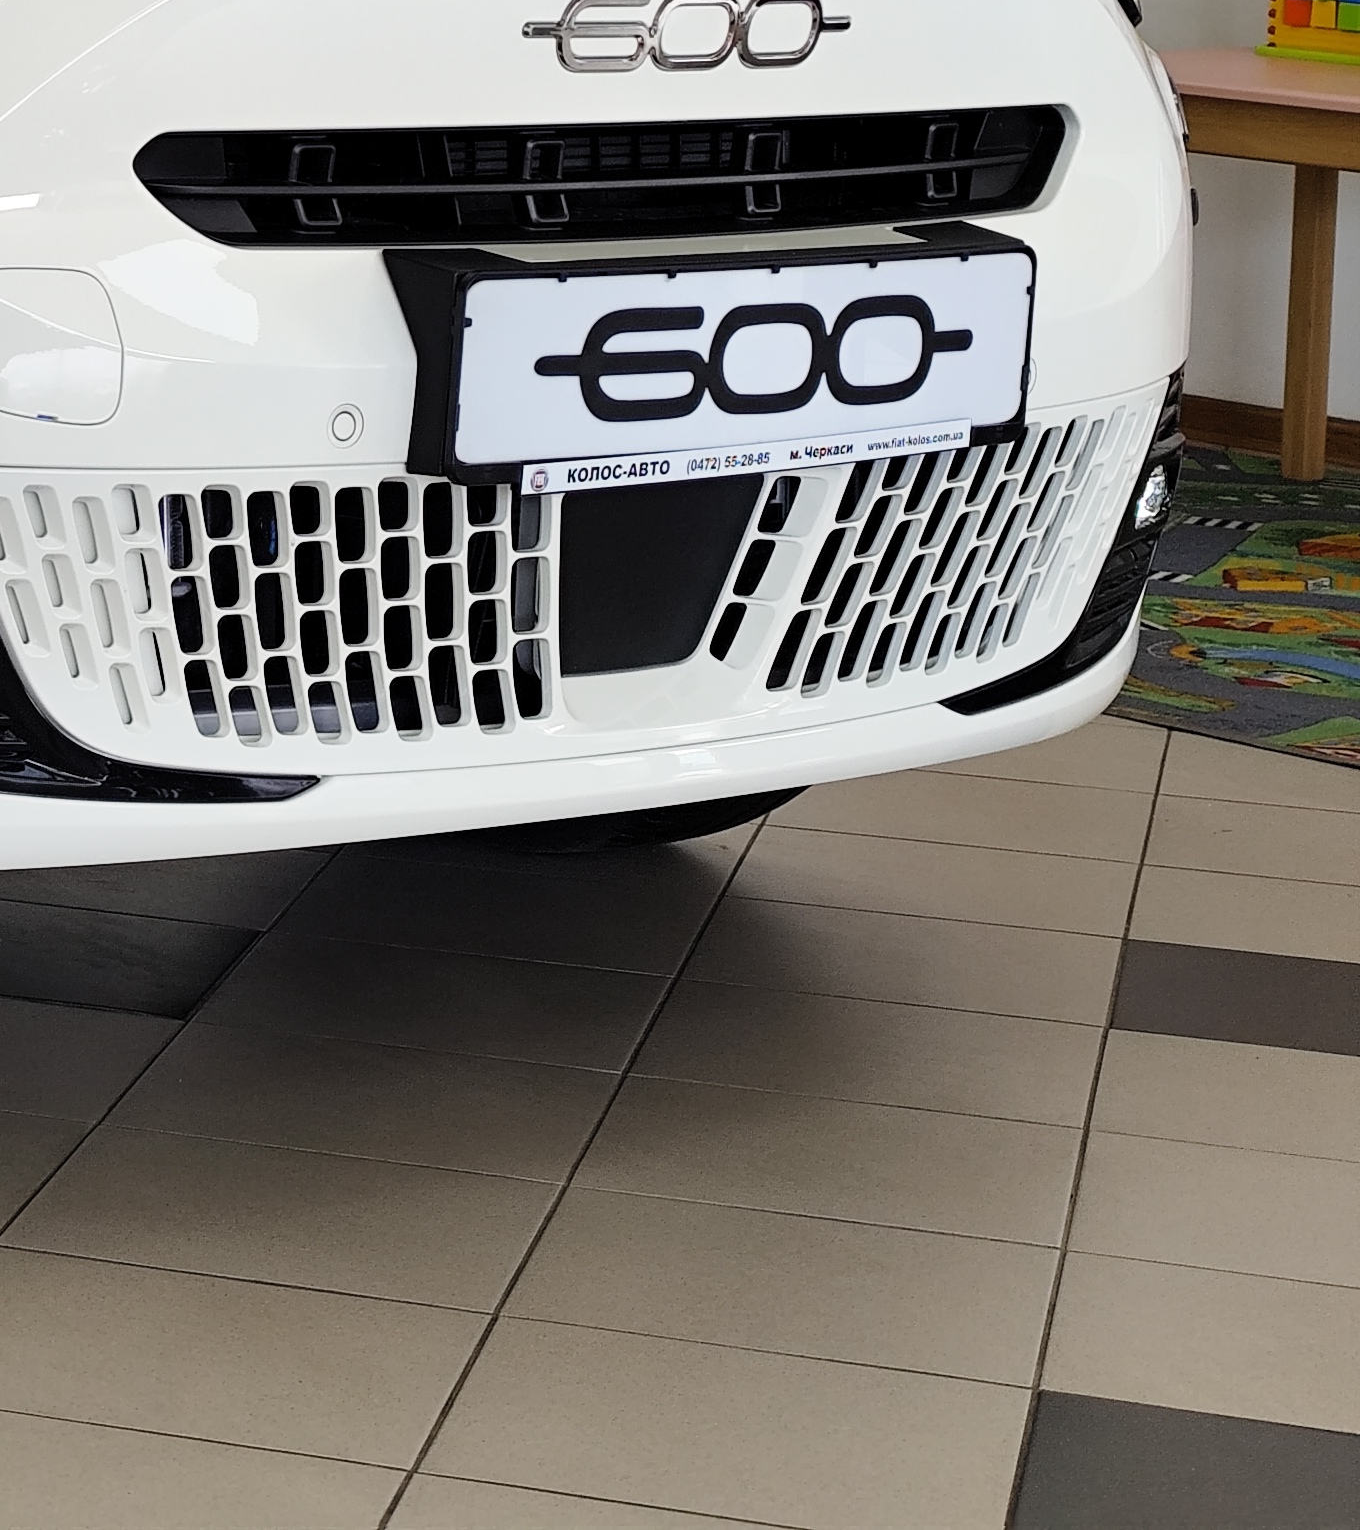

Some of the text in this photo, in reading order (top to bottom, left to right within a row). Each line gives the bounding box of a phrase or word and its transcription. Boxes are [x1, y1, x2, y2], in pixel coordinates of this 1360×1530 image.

[534, 294, 972, 422] 600
[567, 460, 671, 483] КОЛОС-АВТО
[686, 455, 721, 472] (0472)
[724, 451, 771, 469] 55-28-85
[790, 449, 802, 461] м.
[805, 443, 854, 461] Черкаси
[868, 431, 964, 452] www.fiat-kolos.com.ua
